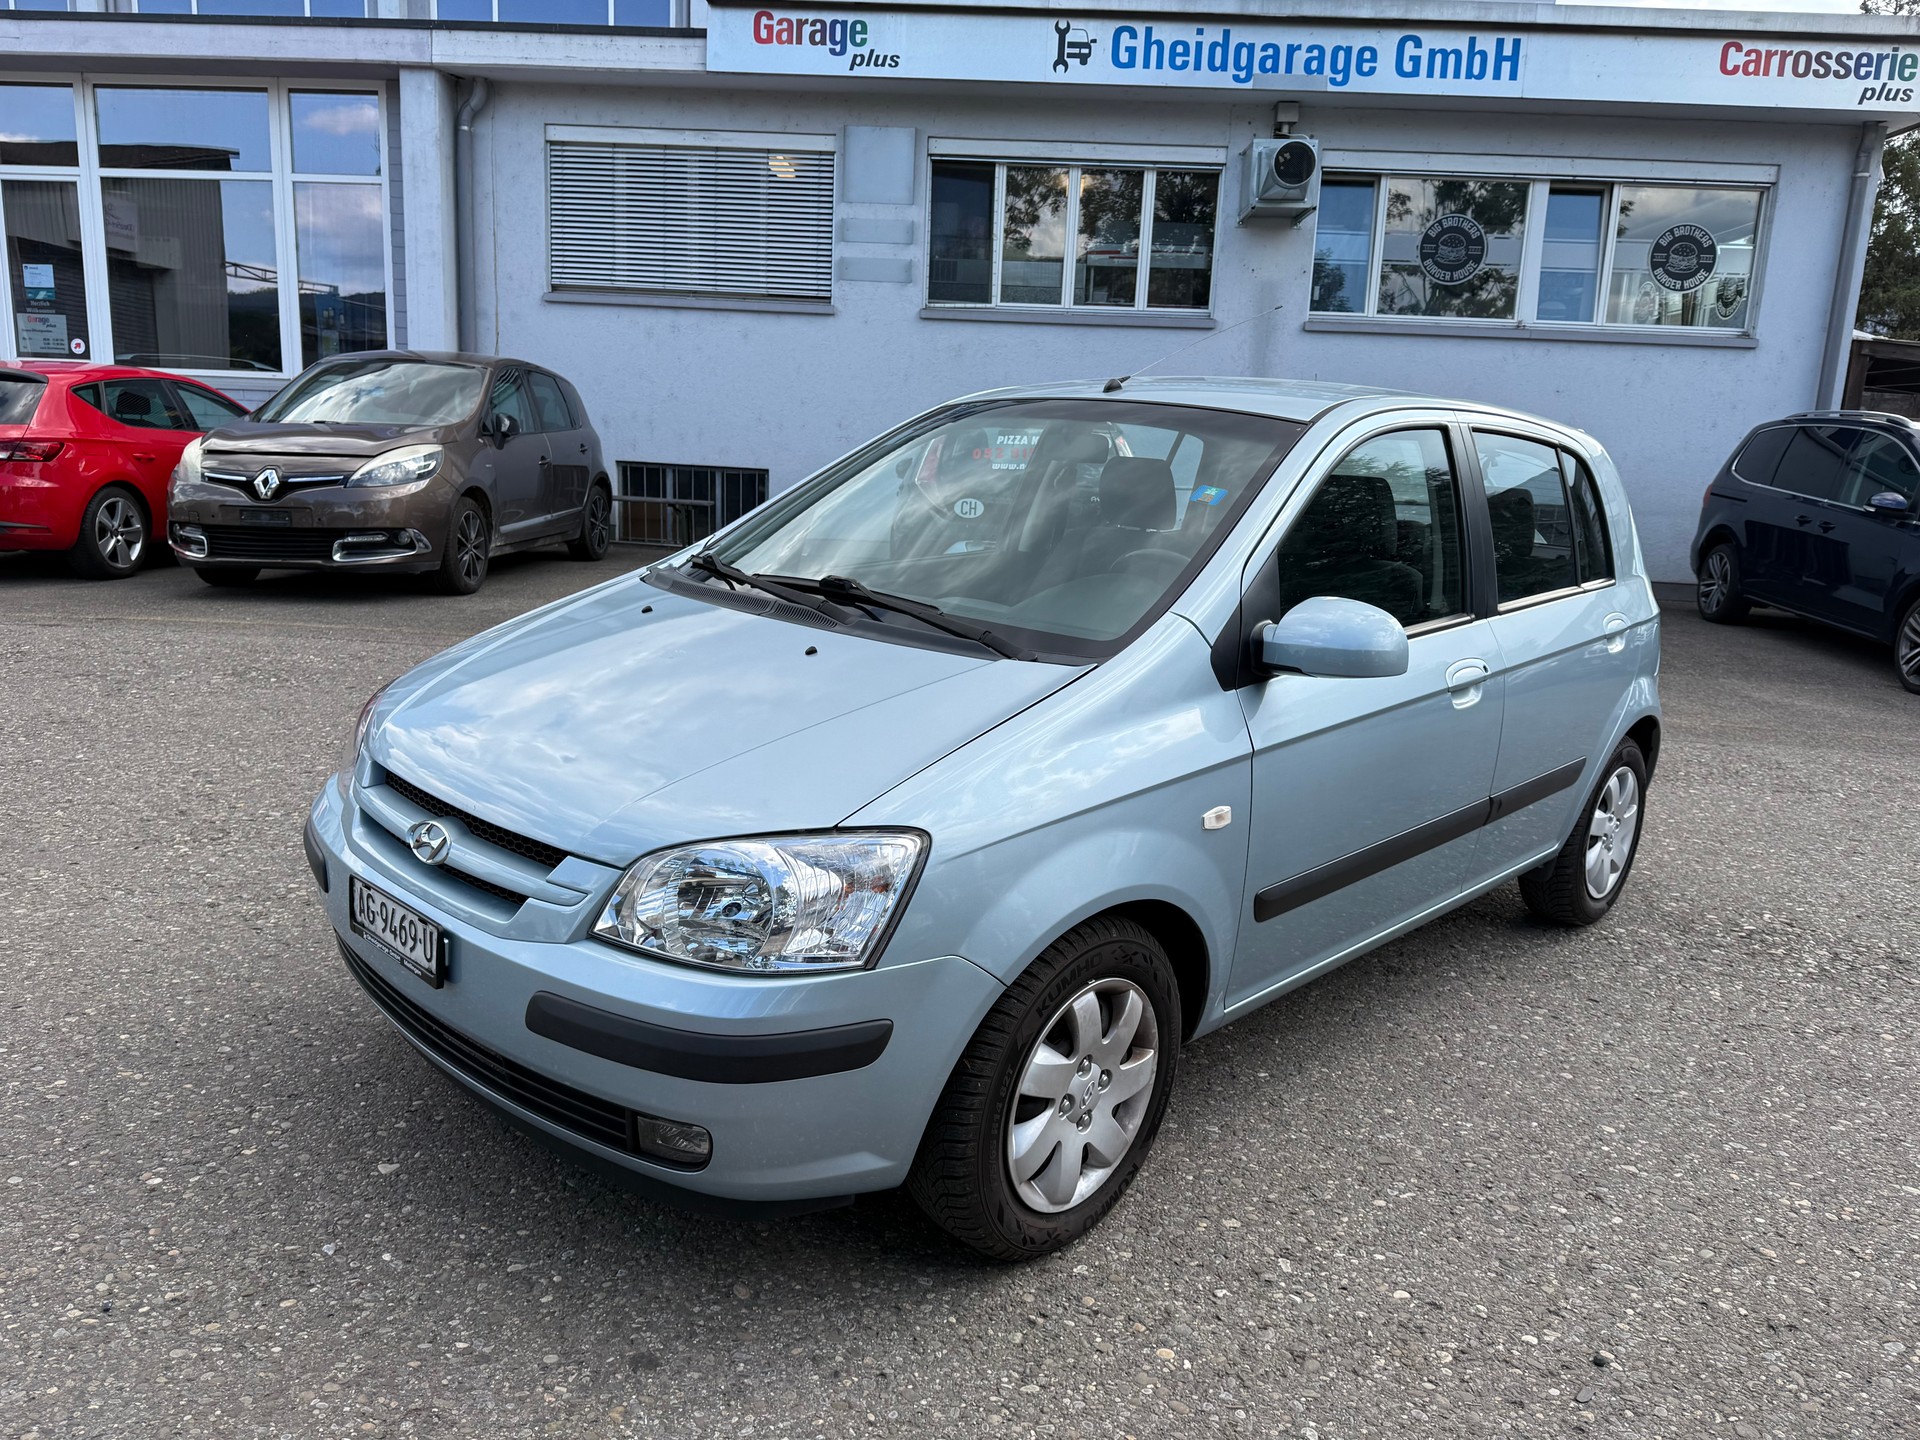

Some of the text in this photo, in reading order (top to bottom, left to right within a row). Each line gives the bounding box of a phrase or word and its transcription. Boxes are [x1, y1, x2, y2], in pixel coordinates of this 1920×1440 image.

[753, 10, 868, 56] Garage
[849, 48, 901, 71] plus
[1111, 25, 1522, 87] Gheidgarage GmbH
[1719, 41, 1918, 82] Carrosserie
[1858, 82, 1914, 106] plus
[1428, 217, 1481, 239] BIG BROTHERS
[1659, 225, 1713, 248] BIG BROTHERS
[1423, 258, 1478, 281] BURGER HOUSE
[1653, 267, 1710, 290] BURGER HOUSE
[27, 315, 50, 325] Garage
[996, 435, 1028, 445] PIZZA
[960, 500, 977, 516] CH
[1035, 951, 1103, 1018] KUMHO
